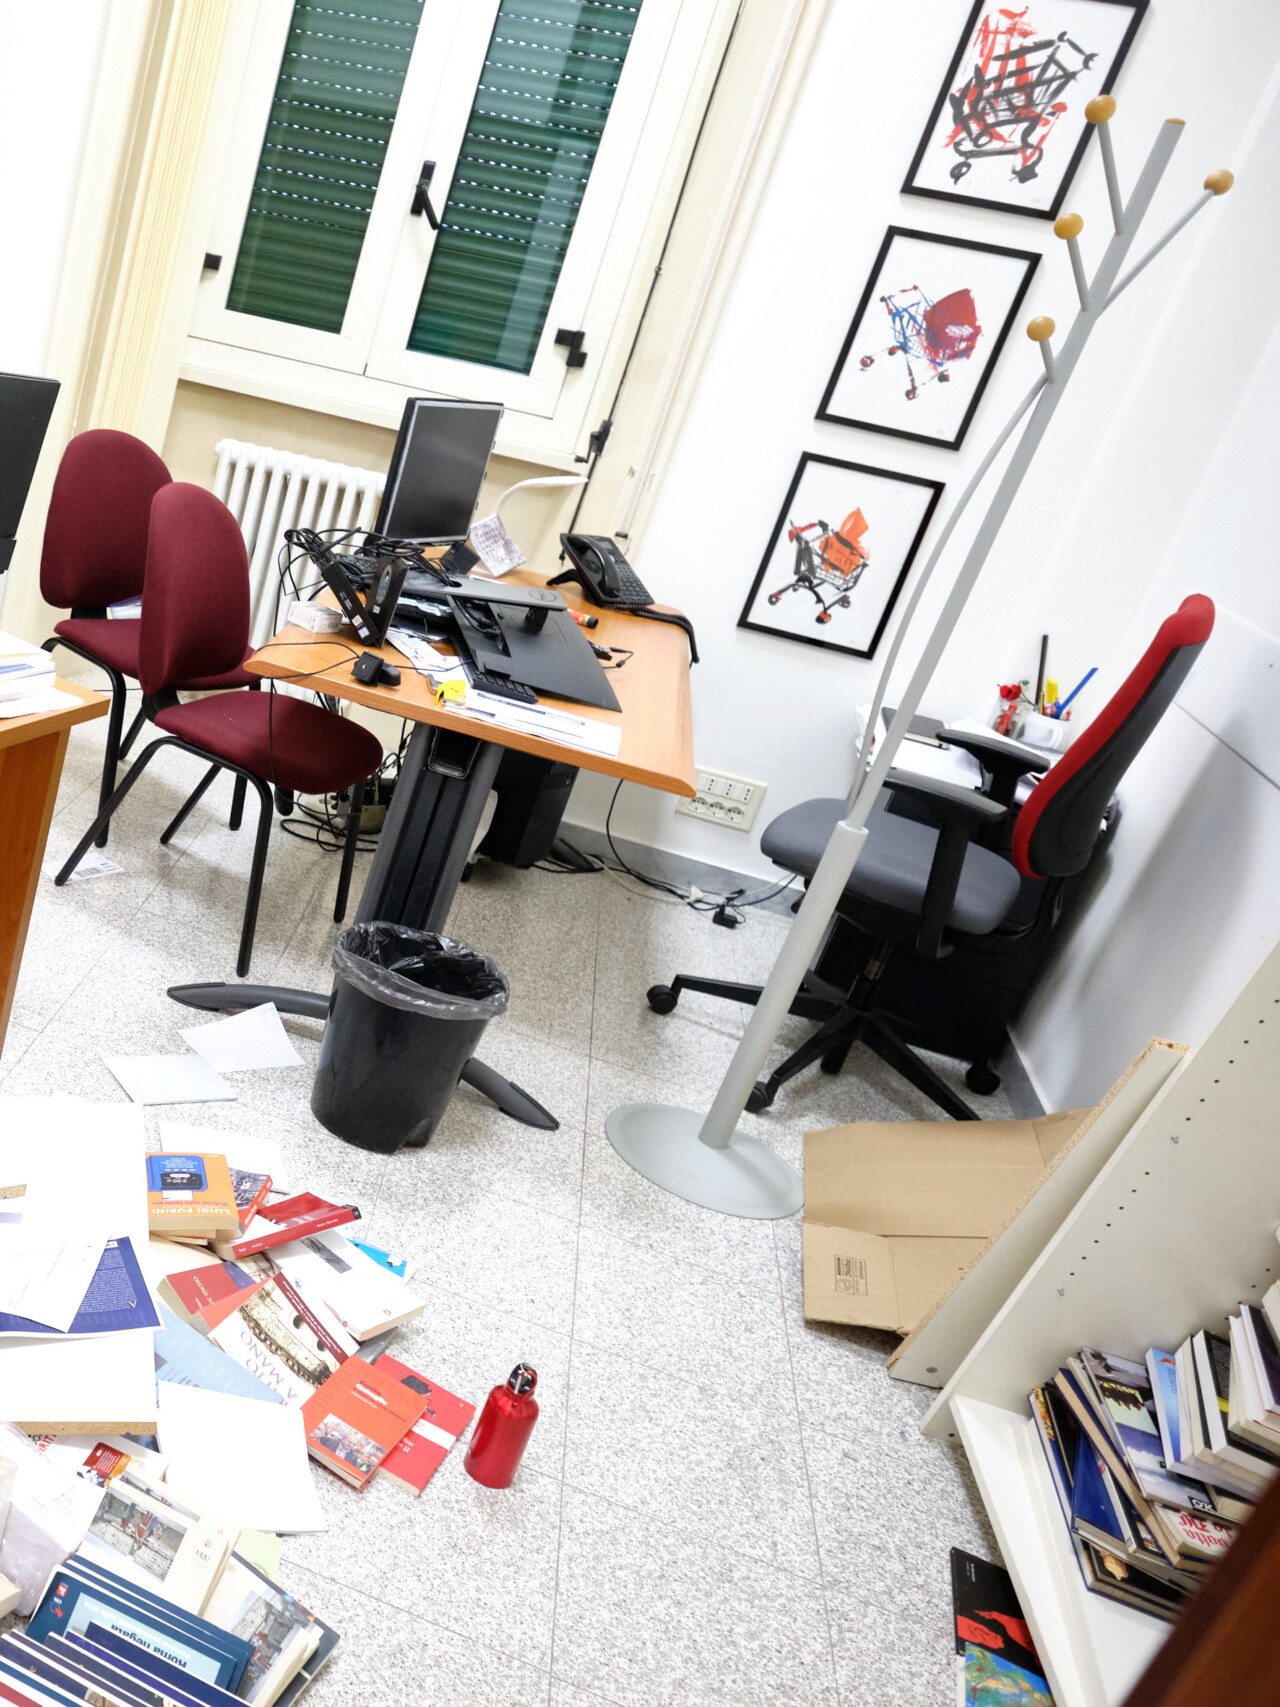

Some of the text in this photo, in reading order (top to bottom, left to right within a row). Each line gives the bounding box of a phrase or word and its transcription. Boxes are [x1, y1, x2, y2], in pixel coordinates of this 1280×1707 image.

[152, 1206, 230, 1215] LUIGI FURINI
[240, 1330, 285, 1386] MANO
